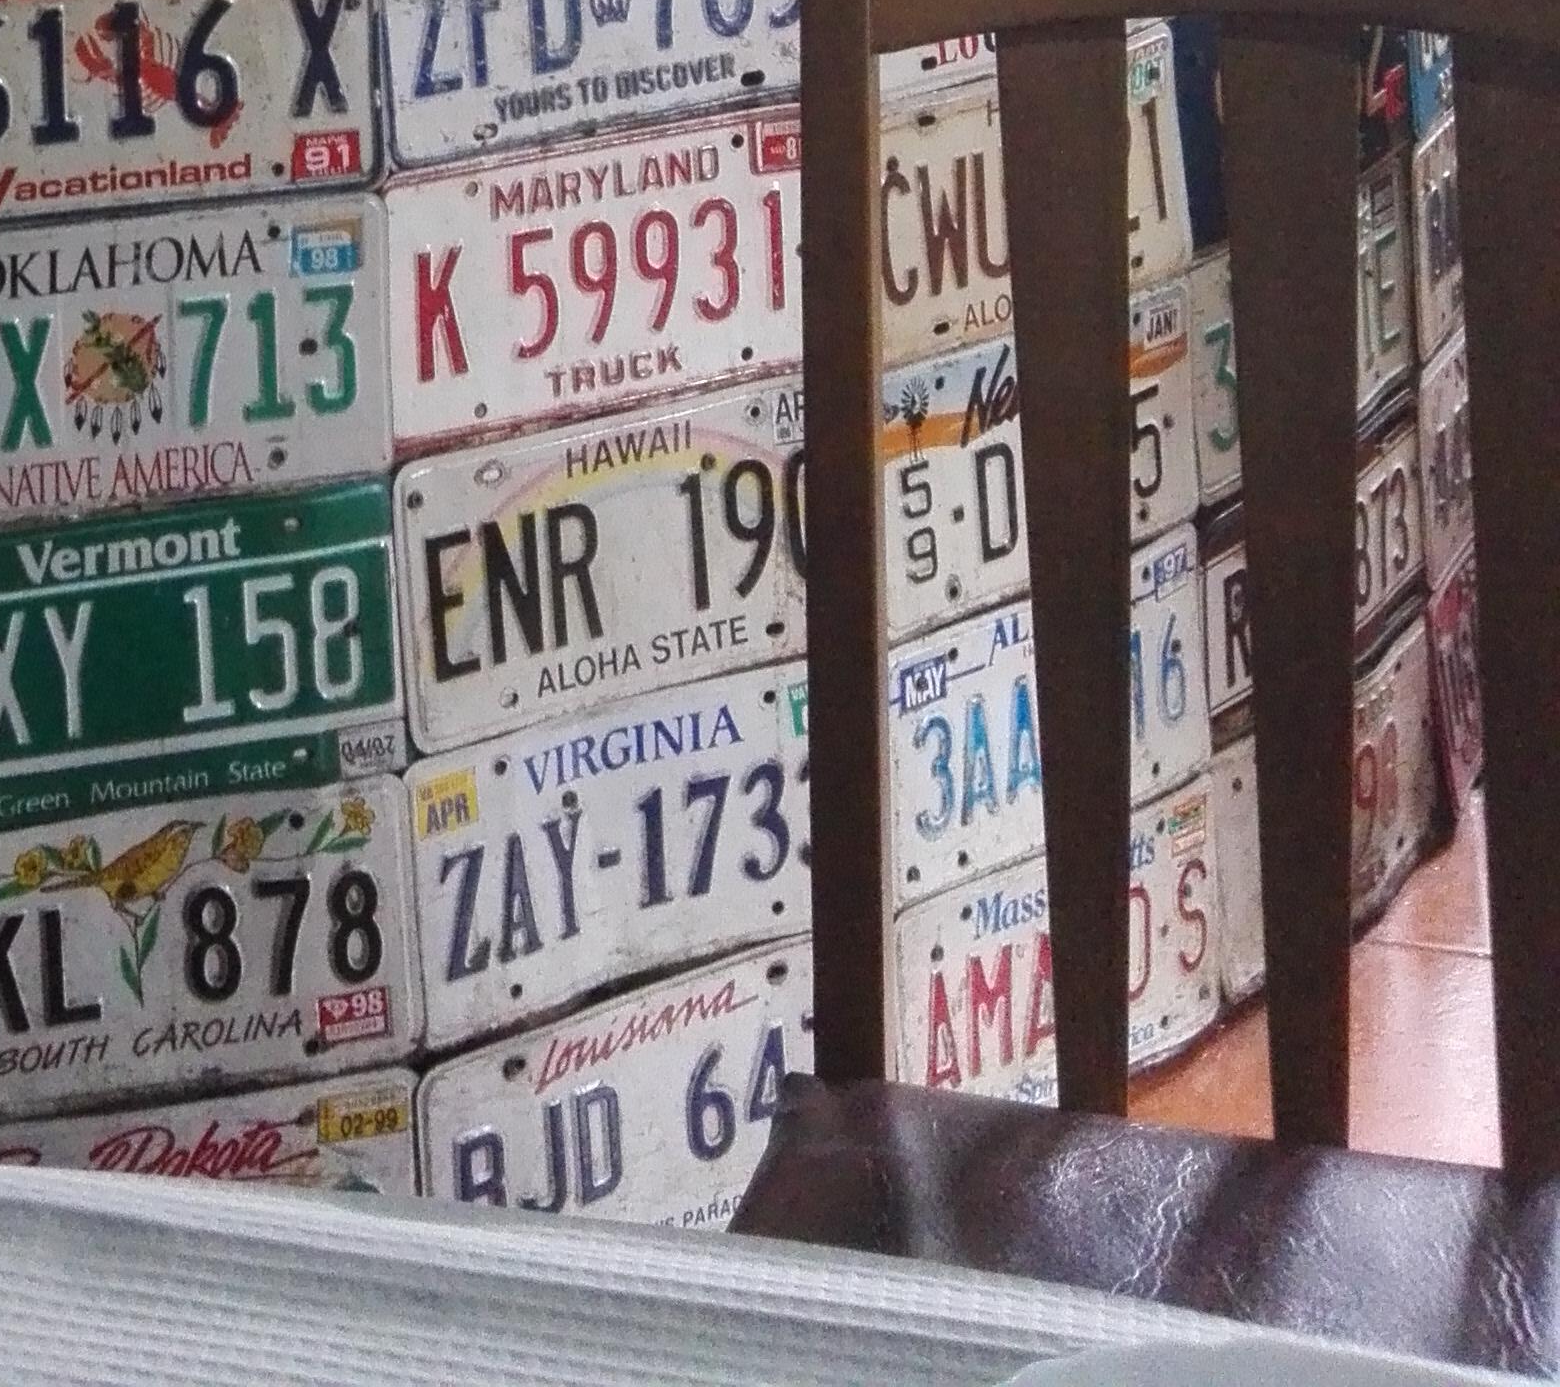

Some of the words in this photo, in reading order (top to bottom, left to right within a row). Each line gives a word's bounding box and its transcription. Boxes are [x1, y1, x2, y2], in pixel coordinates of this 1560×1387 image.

[493, 84, 571, 125] YOURS
[577, 75, 607, 104] TO
[615, 53, 737, 101] DISCOVER
[304, 144, 351, 171] 91
[488, 146, 720, 218] MARYLAND
[414, 244, 469, 384] K
[509, 184, 785, 361] 59931
[963, 292, 1013, 330] ALO
[180, 281, 359, 433] 713
[544, 343, 684, 398] TRUCK
[110, 440, 253, 501] AMERICA
[565, 420, 693, 480] HAWAII
[16, 519, 243, 586] Vermont
[424, 500, 605, 684] ENR
[182, 566, 365, 725] 158
[538, 638, 642, 699] ALOHA
[652, 614, 749, 664] STATE
[988, 616, 1028, 668] AL
[91, 767, 209, 804] Mountain
[228, 758, 286, 784] State
[524, 704, 745, 795] VIRGINIA
[425, 791, 471, 834] APR
[440, 755, 812, 982] ZAY-173
[182, 867, 383, 1003] 878
[974, 883, 1047, 940] Mass
[132, 1008, 302, 1054] CAROLINA
[350, 988, 385, 1019] 98
[534, 977, 761, 1094] Louisiana
[686, 1015, 814, 1162] 64
[89, 1119, 287, 1176] Dakota
[340, 1108, 399, 1136] 02-99
